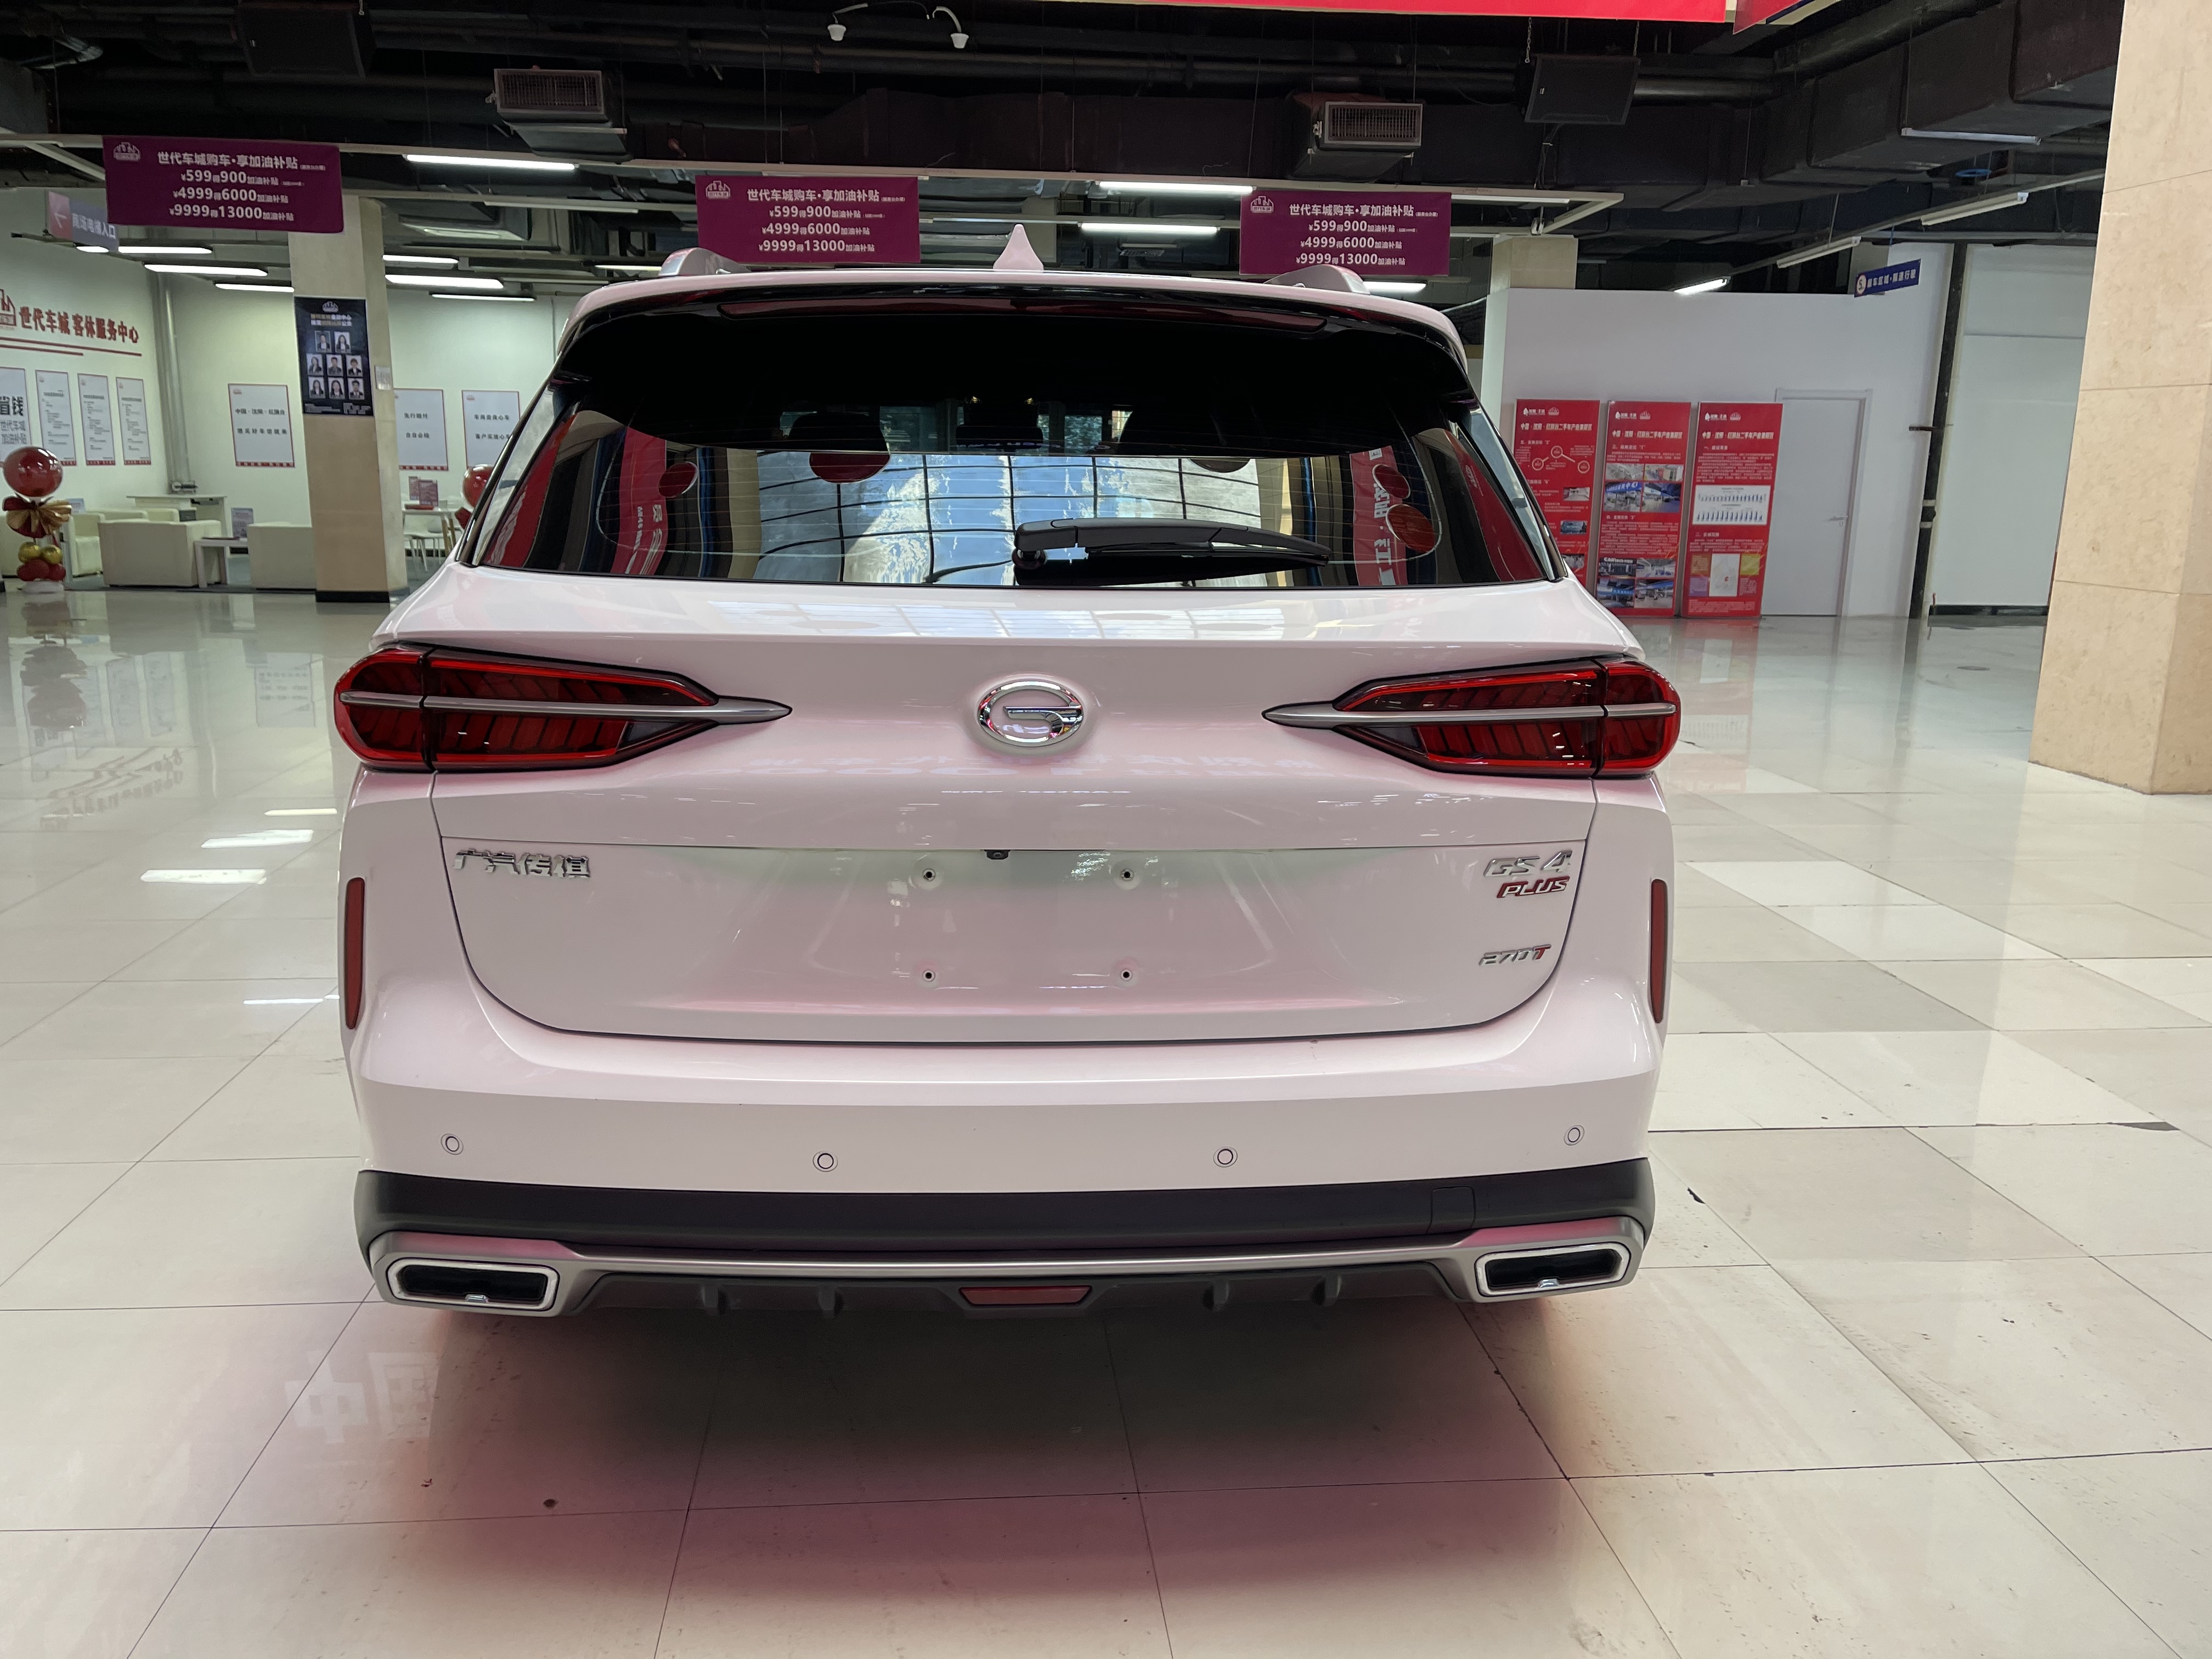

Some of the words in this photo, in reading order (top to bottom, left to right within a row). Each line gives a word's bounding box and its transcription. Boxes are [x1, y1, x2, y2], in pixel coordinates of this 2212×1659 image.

[157, 151, 298, 170] 世代车城购车·享加油补贴
[747, 189, 879, 202] 世代车城购车·享加油补贴
[1289, 204, 1414, 217] 世代车城购车·享加油补贴
[1496, 876, 1571, 898] PLUS
[1479, 944, 1552, 966] 270T
